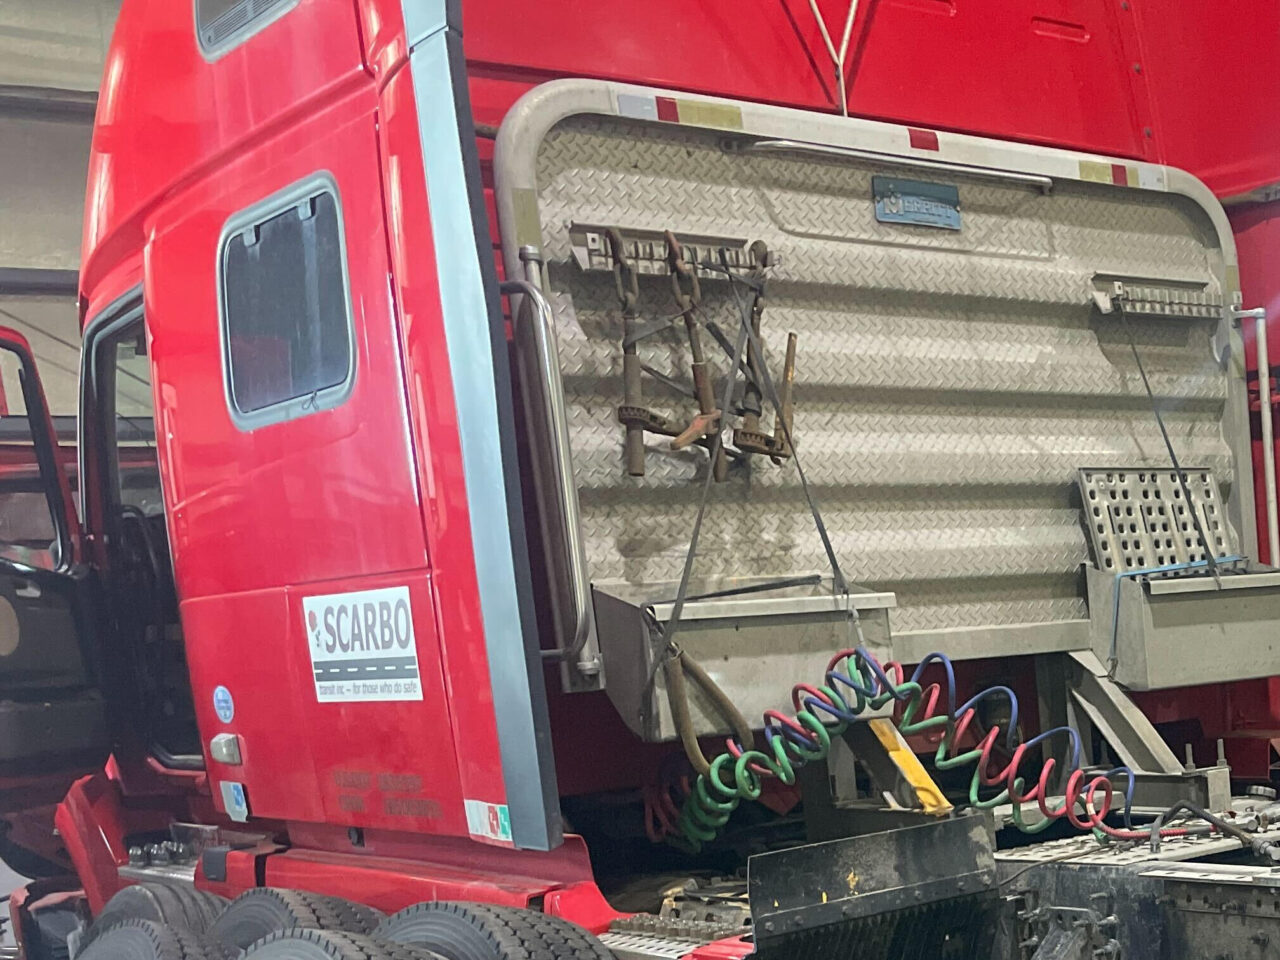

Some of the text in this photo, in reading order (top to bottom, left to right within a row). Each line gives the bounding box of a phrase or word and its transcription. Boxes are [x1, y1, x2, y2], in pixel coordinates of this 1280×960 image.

[323, 598, 411, 654] SCARBO
[352, 682, 361, 694] for
[362, 682, 378, 694] those
[380, 682, 393, 694] who
[394, 682, 402, 694] do
[404, 680, 417, 693] safe
